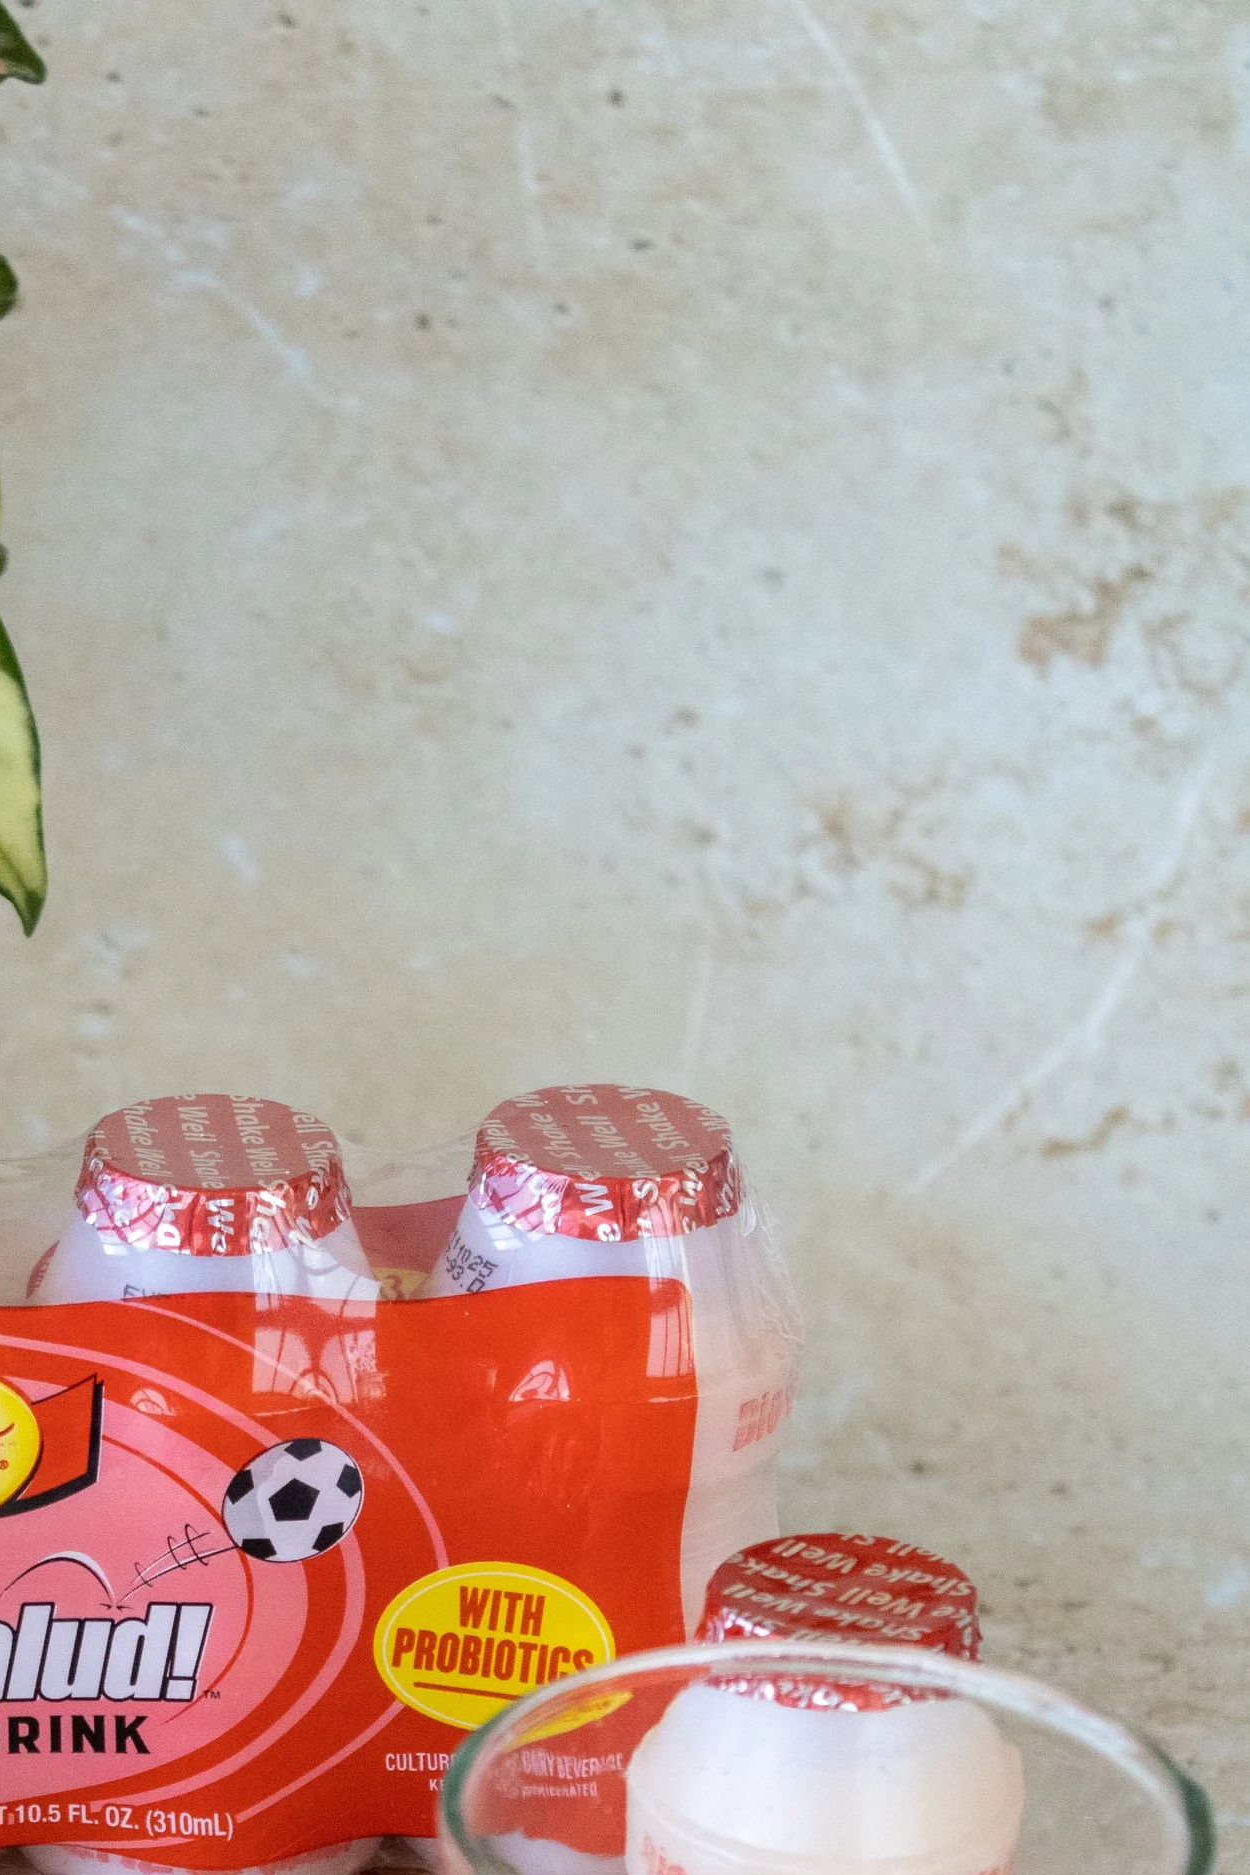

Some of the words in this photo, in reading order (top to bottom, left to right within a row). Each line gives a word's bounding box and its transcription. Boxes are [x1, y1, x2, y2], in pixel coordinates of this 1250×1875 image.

[177, 1106, 218, 1143] Well
[527, 1112, 583, 1161] Shake
[580, 1115, 629, 1150] Well
[636, 1101, 691, 1152] Shake
[135, 1147, 173, 1177] Well
[246, 1147, 290, 1177] Well
[772, 1540, 859, 1575] Well
[864, 1562, 973, 1597] Shake
[459, 1585, 546, 1637] WITH
[721, 1583, 807, 1615] Well
[837, 1586, 925, 1619] Well
[392, 1627, 594, 1686] PROBIOTICS
[15, 1804, 61, 1824] 10.5
[68, 1803, 99, 1826] FL.
[105, 1805, 139, 1830] OZ.
[145, 1810, 234, 1841] (310mL)
